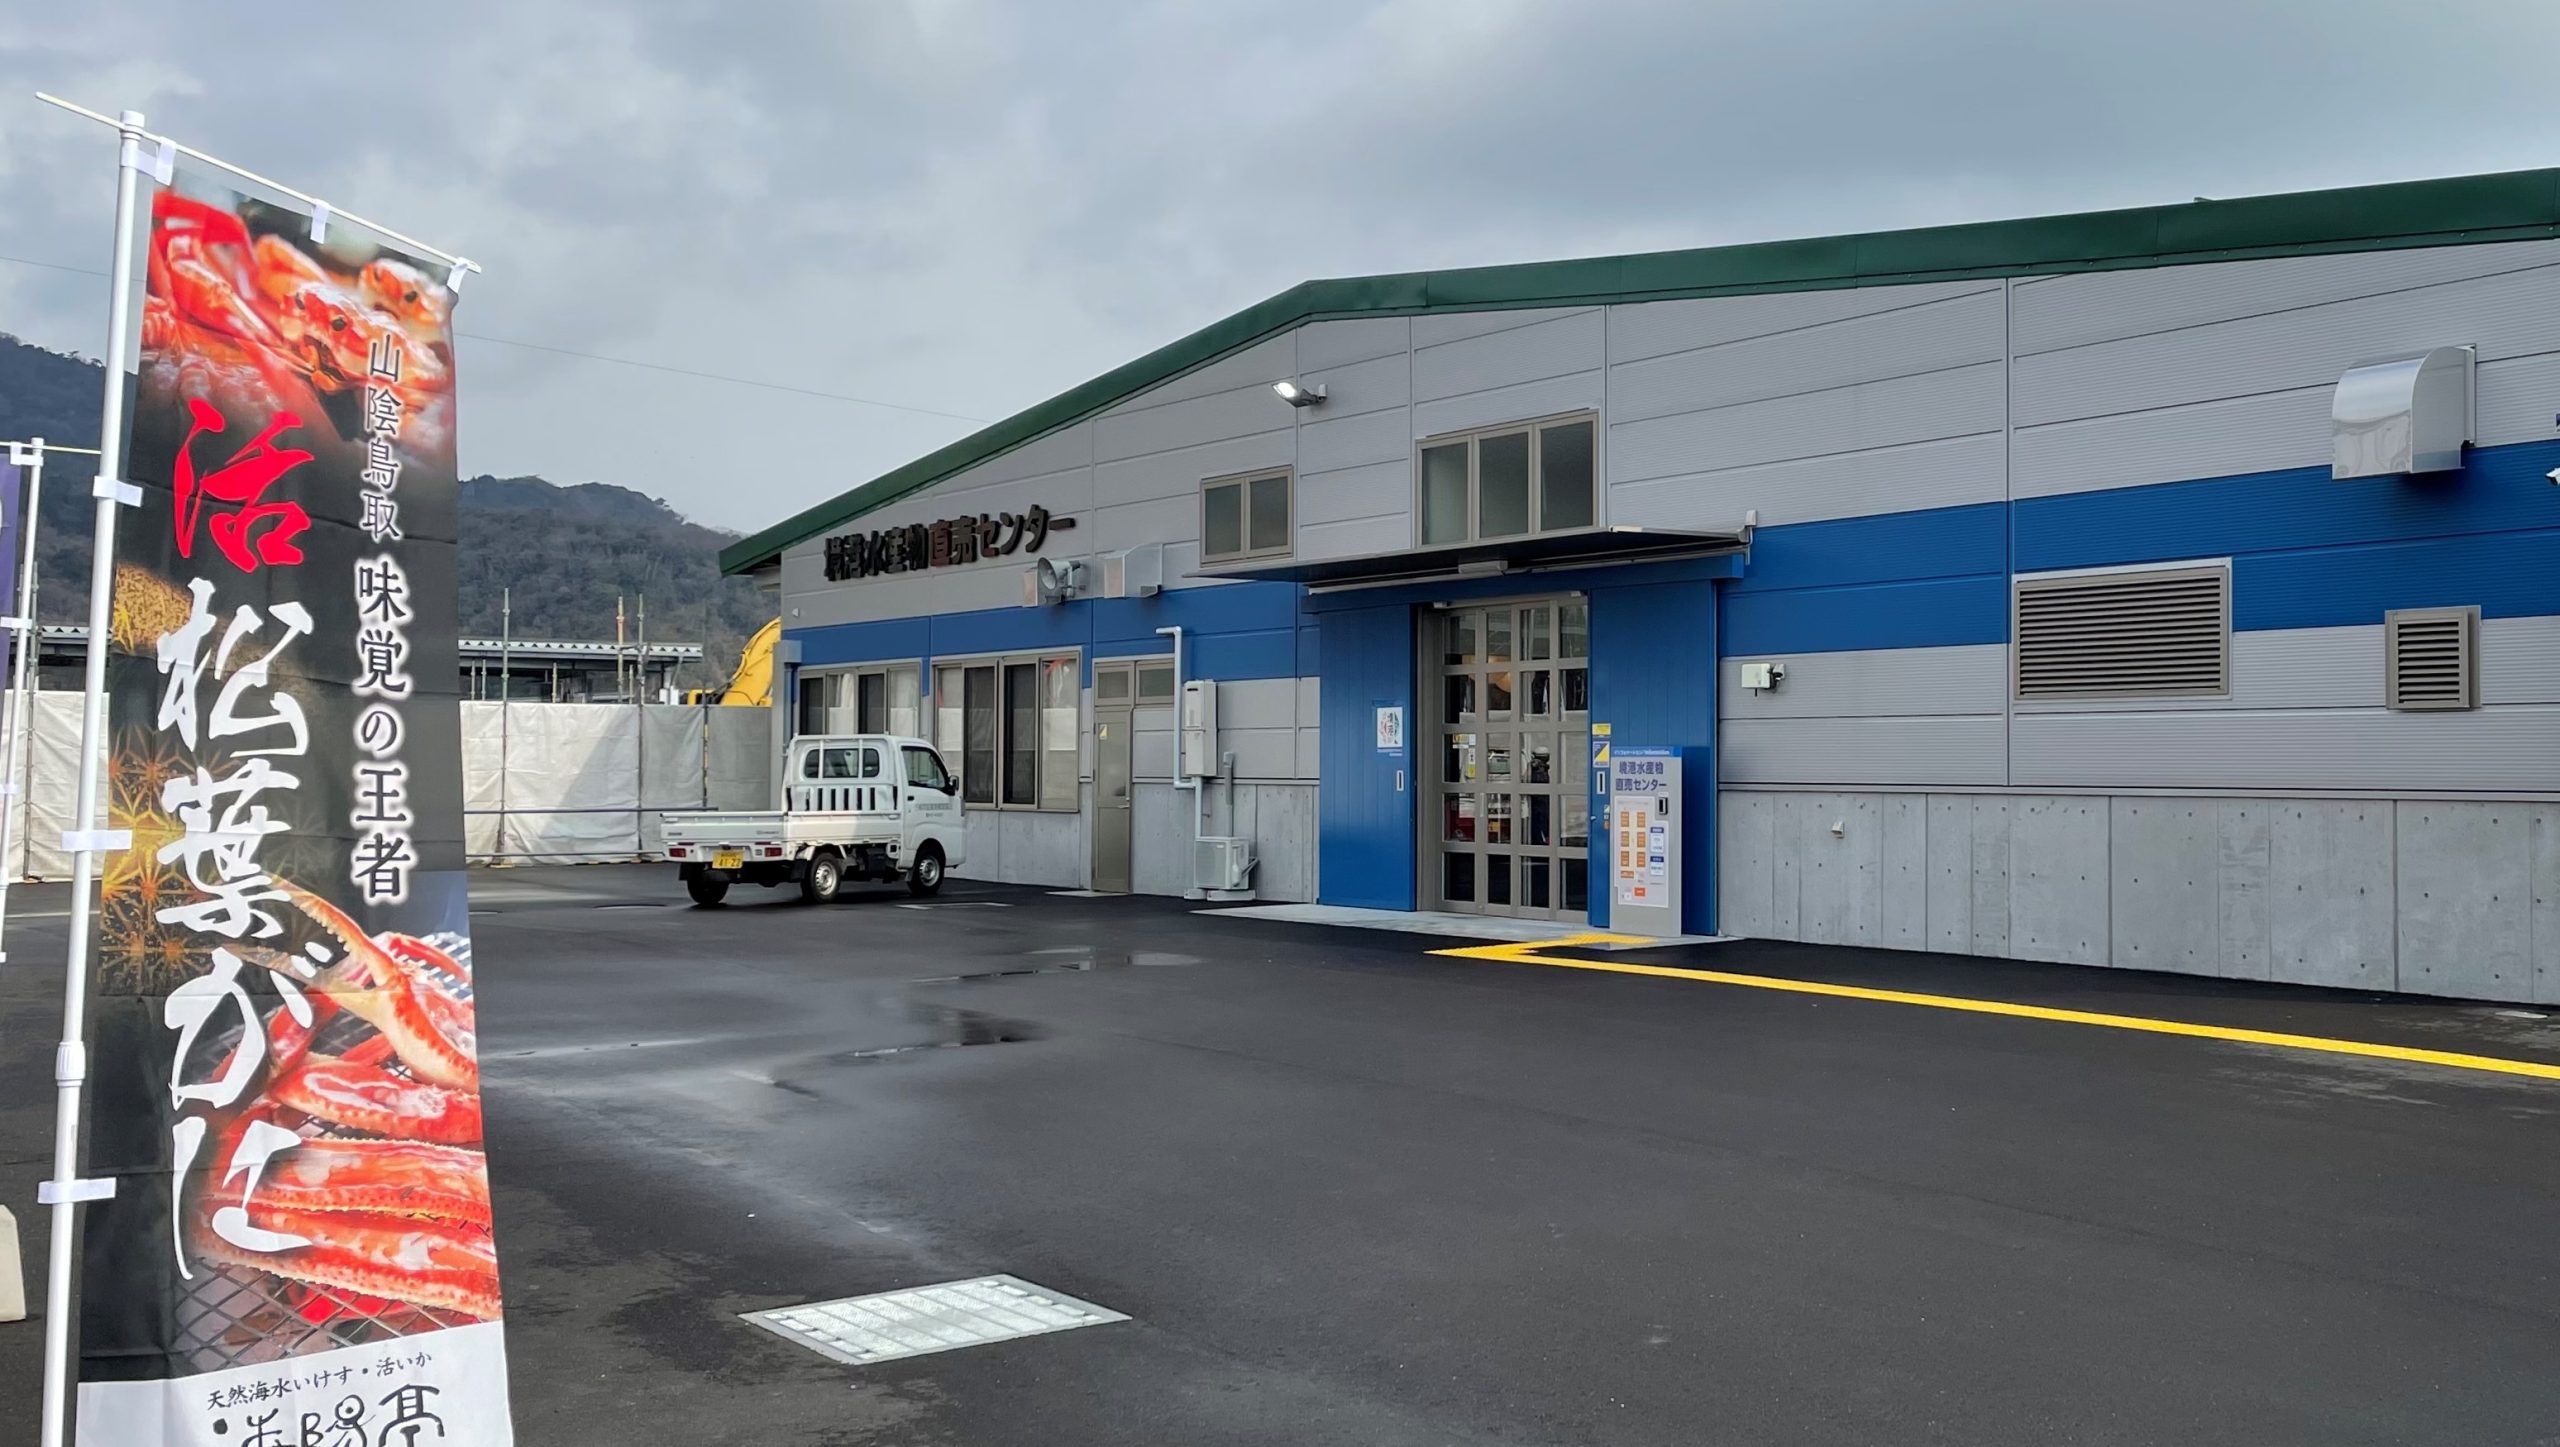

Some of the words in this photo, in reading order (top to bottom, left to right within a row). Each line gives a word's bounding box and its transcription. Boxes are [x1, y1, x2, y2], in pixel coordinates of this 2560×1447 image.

[362, 333, 403, 540] 山陰鳥取
[355, 560, 411, 899] 味覚の王者
[1615, 778, 1667, 792] 直売センター
